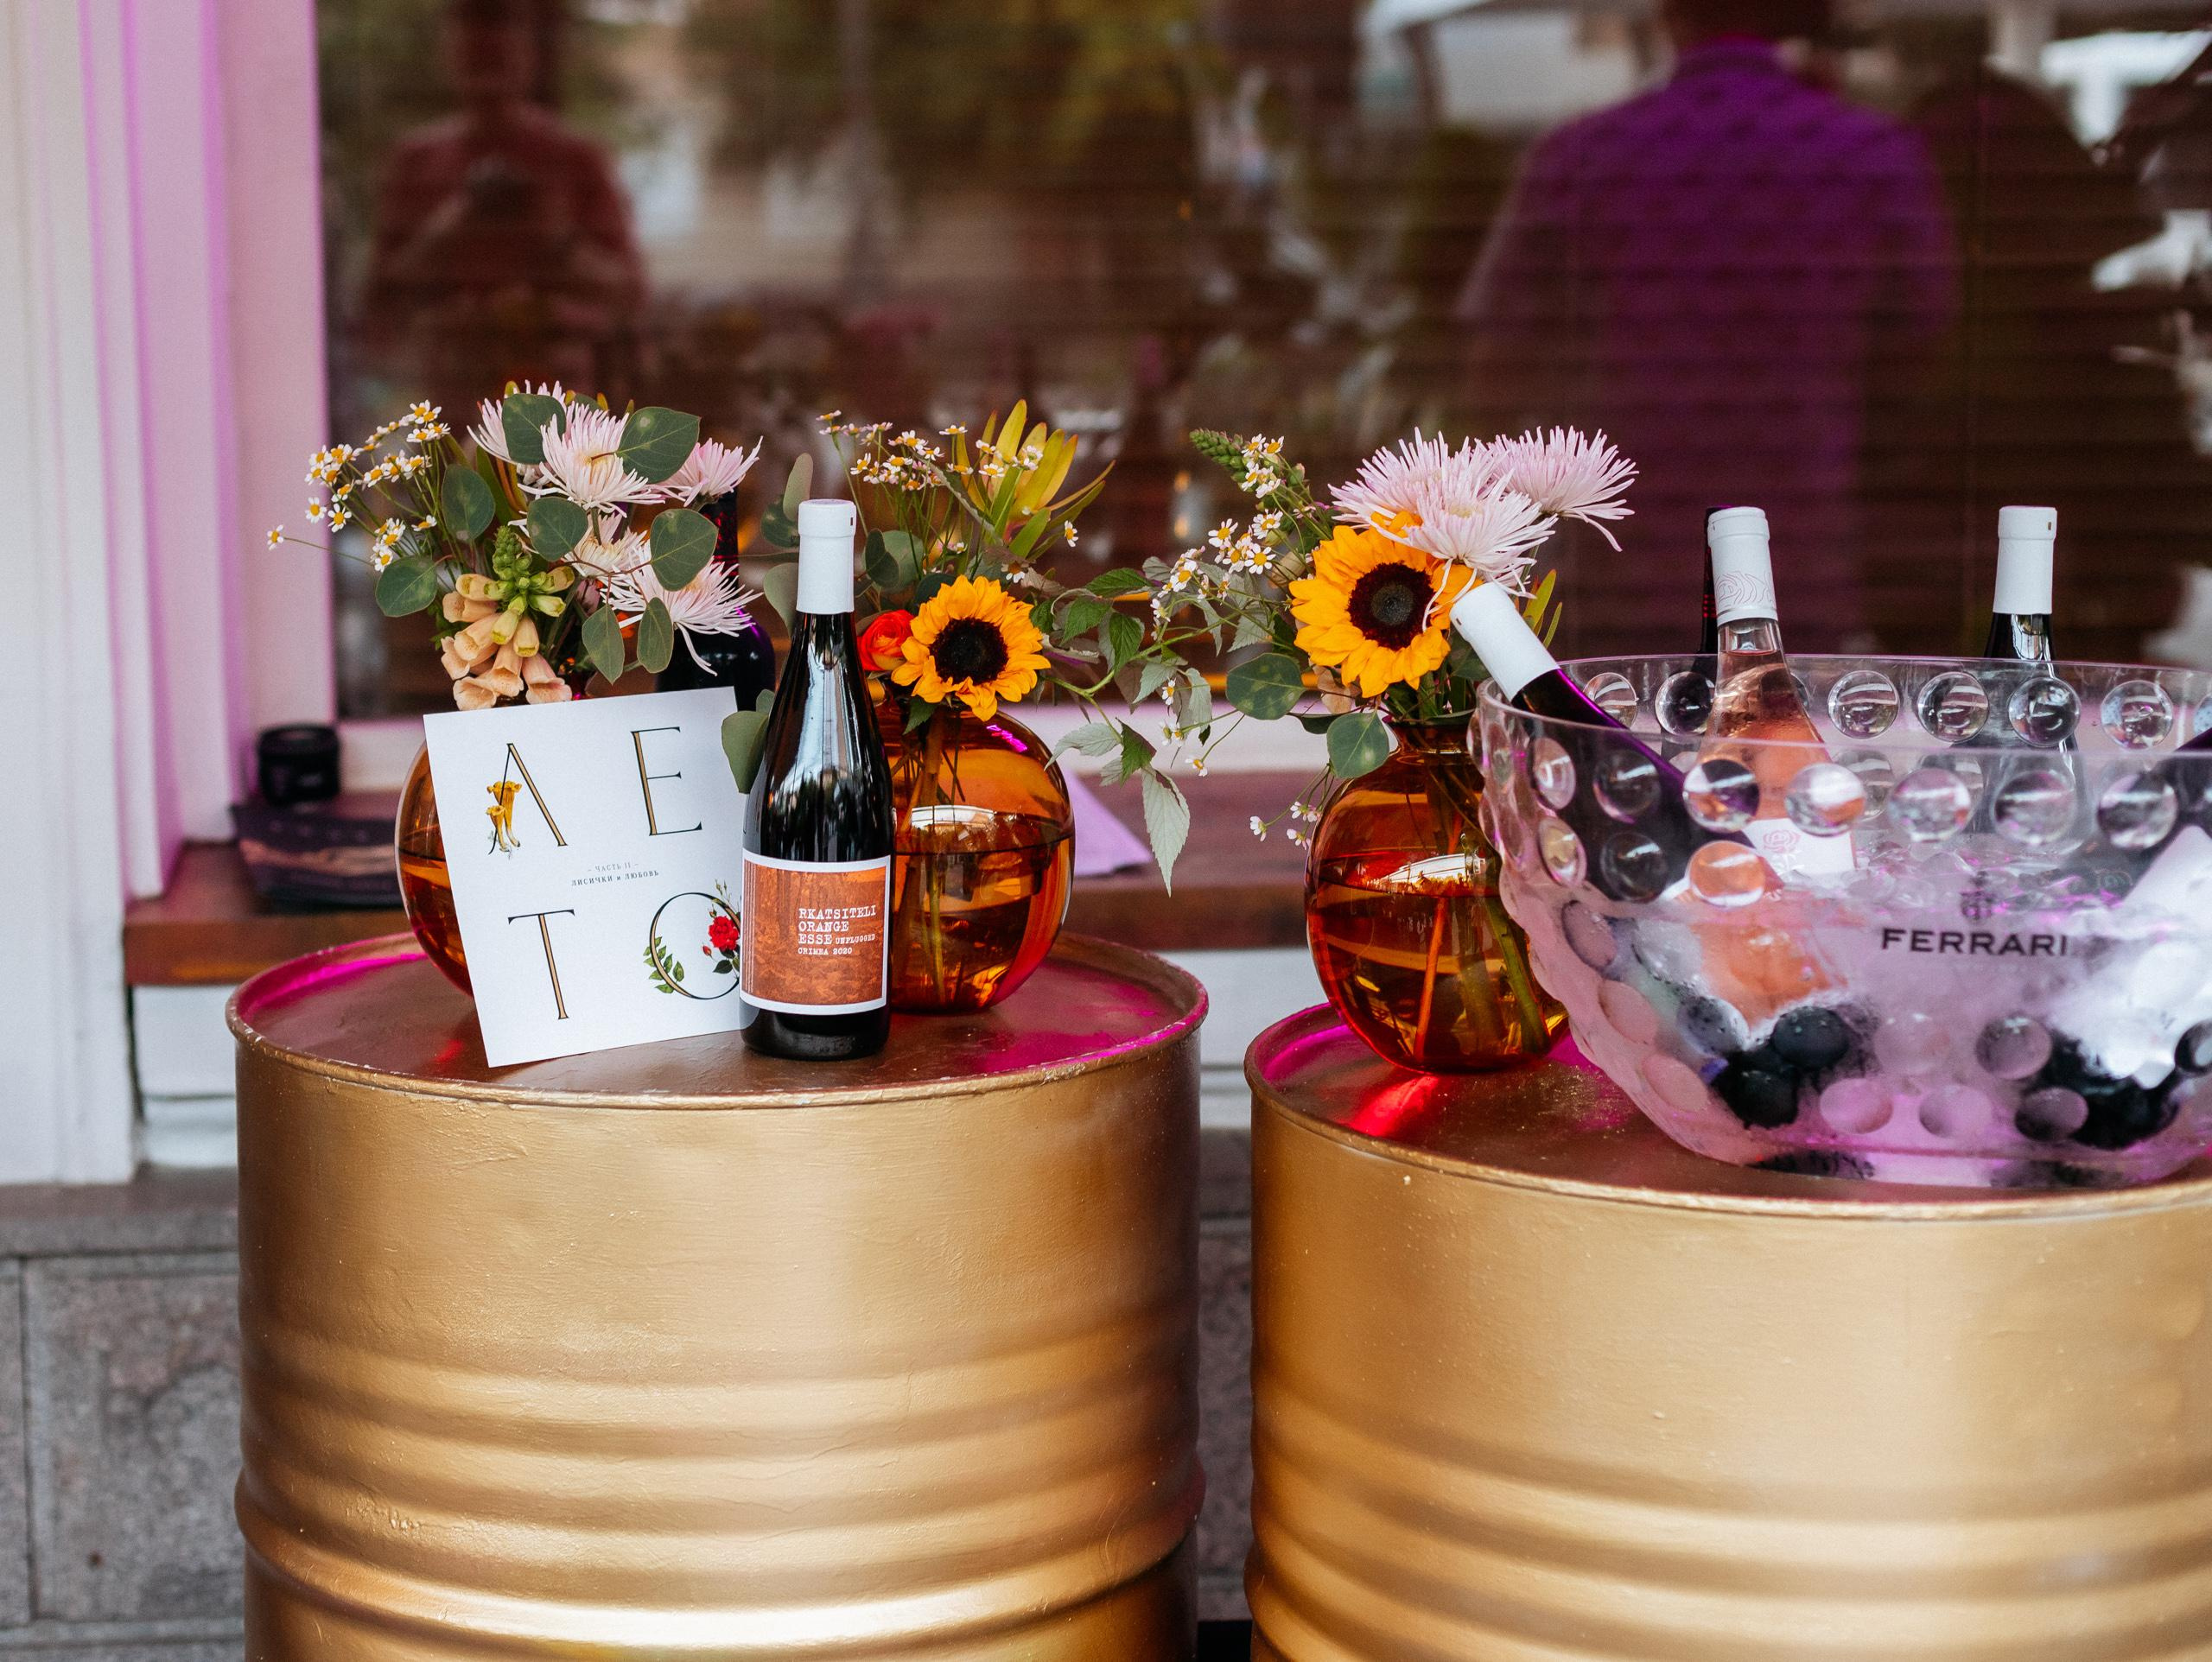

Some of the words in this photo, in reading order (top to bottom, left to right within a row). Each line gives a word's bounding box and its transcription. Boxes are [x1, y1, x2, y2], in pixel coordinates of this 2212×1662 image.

[571, 874, 613, 886] ЛИСИЧКИ
[625, 870, 659, 880] ЛЮБОВЬ
[798, 904, 876, 920] RKATSITELI
[798, 921, 849, 933] ORANGE
[798, 933, 832, 945] ESSE
[835, 933, 876, 945] UNPLUGGED
[1882, 928, 2068, 956] FERRARI
[798, 947, 829, 955] CRIMEA
[832, 947, 853, 955] 2020
